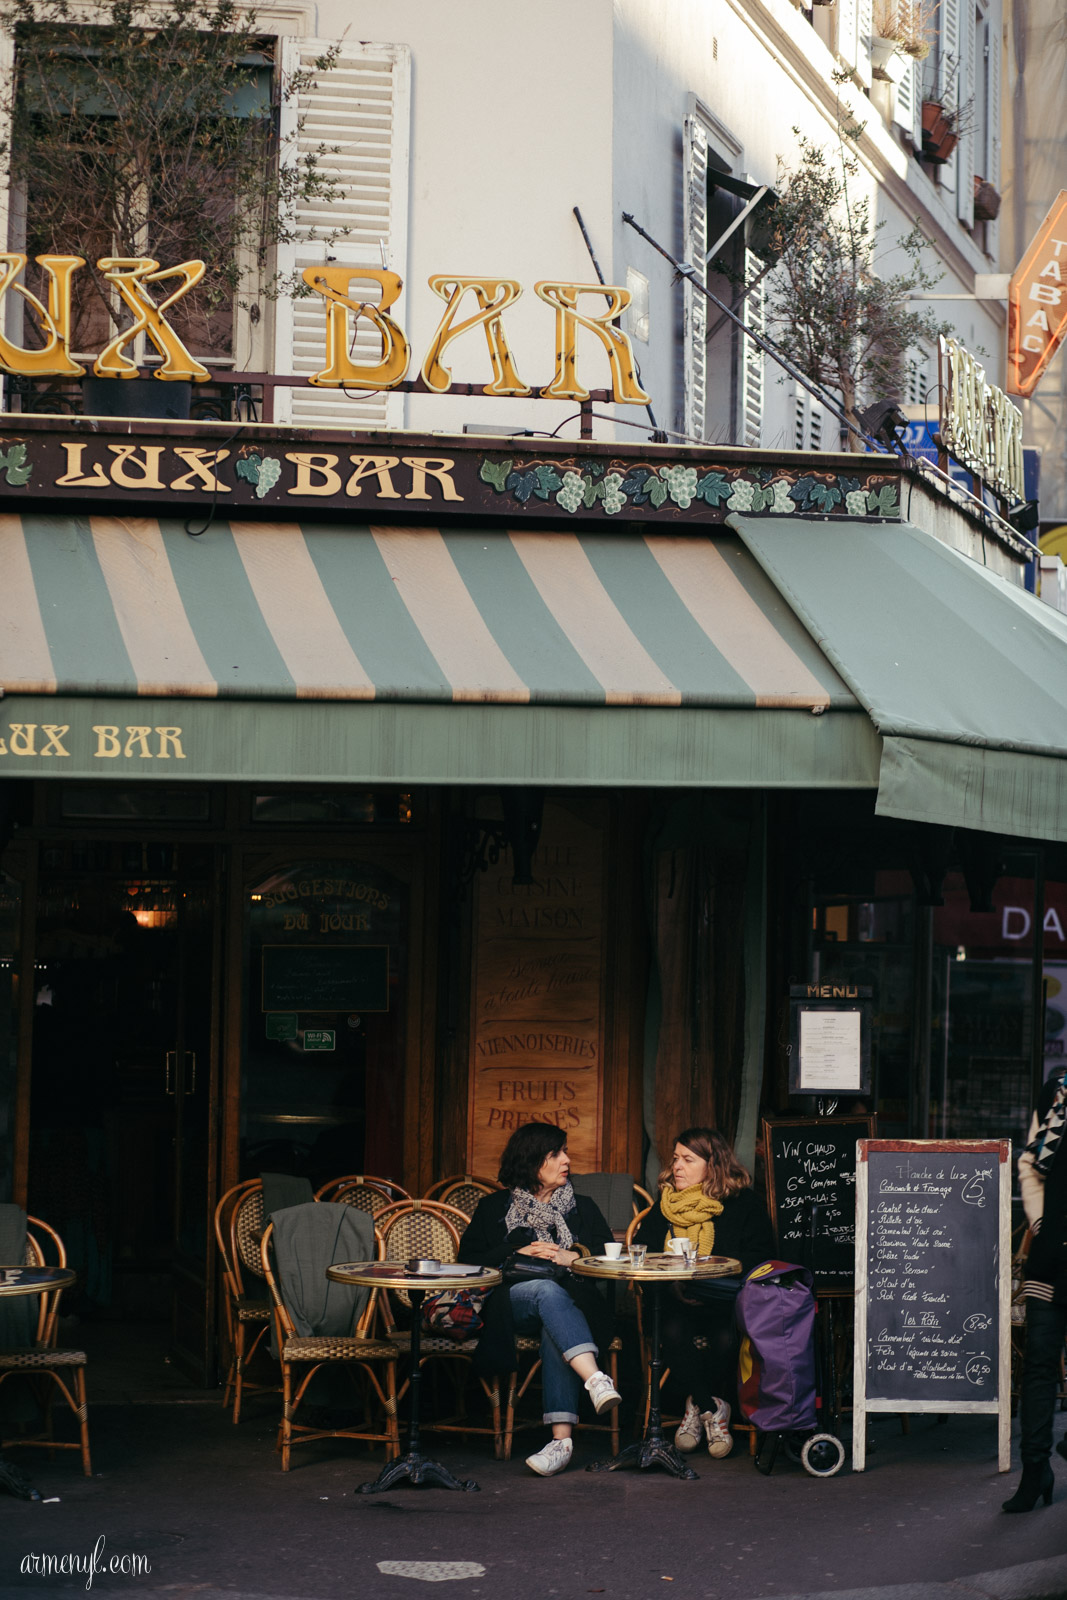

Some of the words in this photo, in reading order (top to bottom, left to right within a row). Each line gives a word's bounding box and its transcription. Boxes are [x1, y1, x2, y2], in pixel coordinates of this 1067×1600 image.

[1022, 238, 1067, 353] TABAC
[303, 267, 651, 404] BAR
[56, 442, 231, 494] LUX
[285, 452, 464, 501] BAR
[93, 724, 187, 759] BAR
[263, 879, 391, 910] SUGGESTIONS
[283, 912, 310, 931] DU
[319, 912, 371, 933] JOUR
[807, 985, 859, 998] MENU
[476, 1033, 597, 1059] VIENNOISERIES
[496, 1080, 577, 1102] FRUITS
[487, 1102, 581, 1131] PRESSÉS
